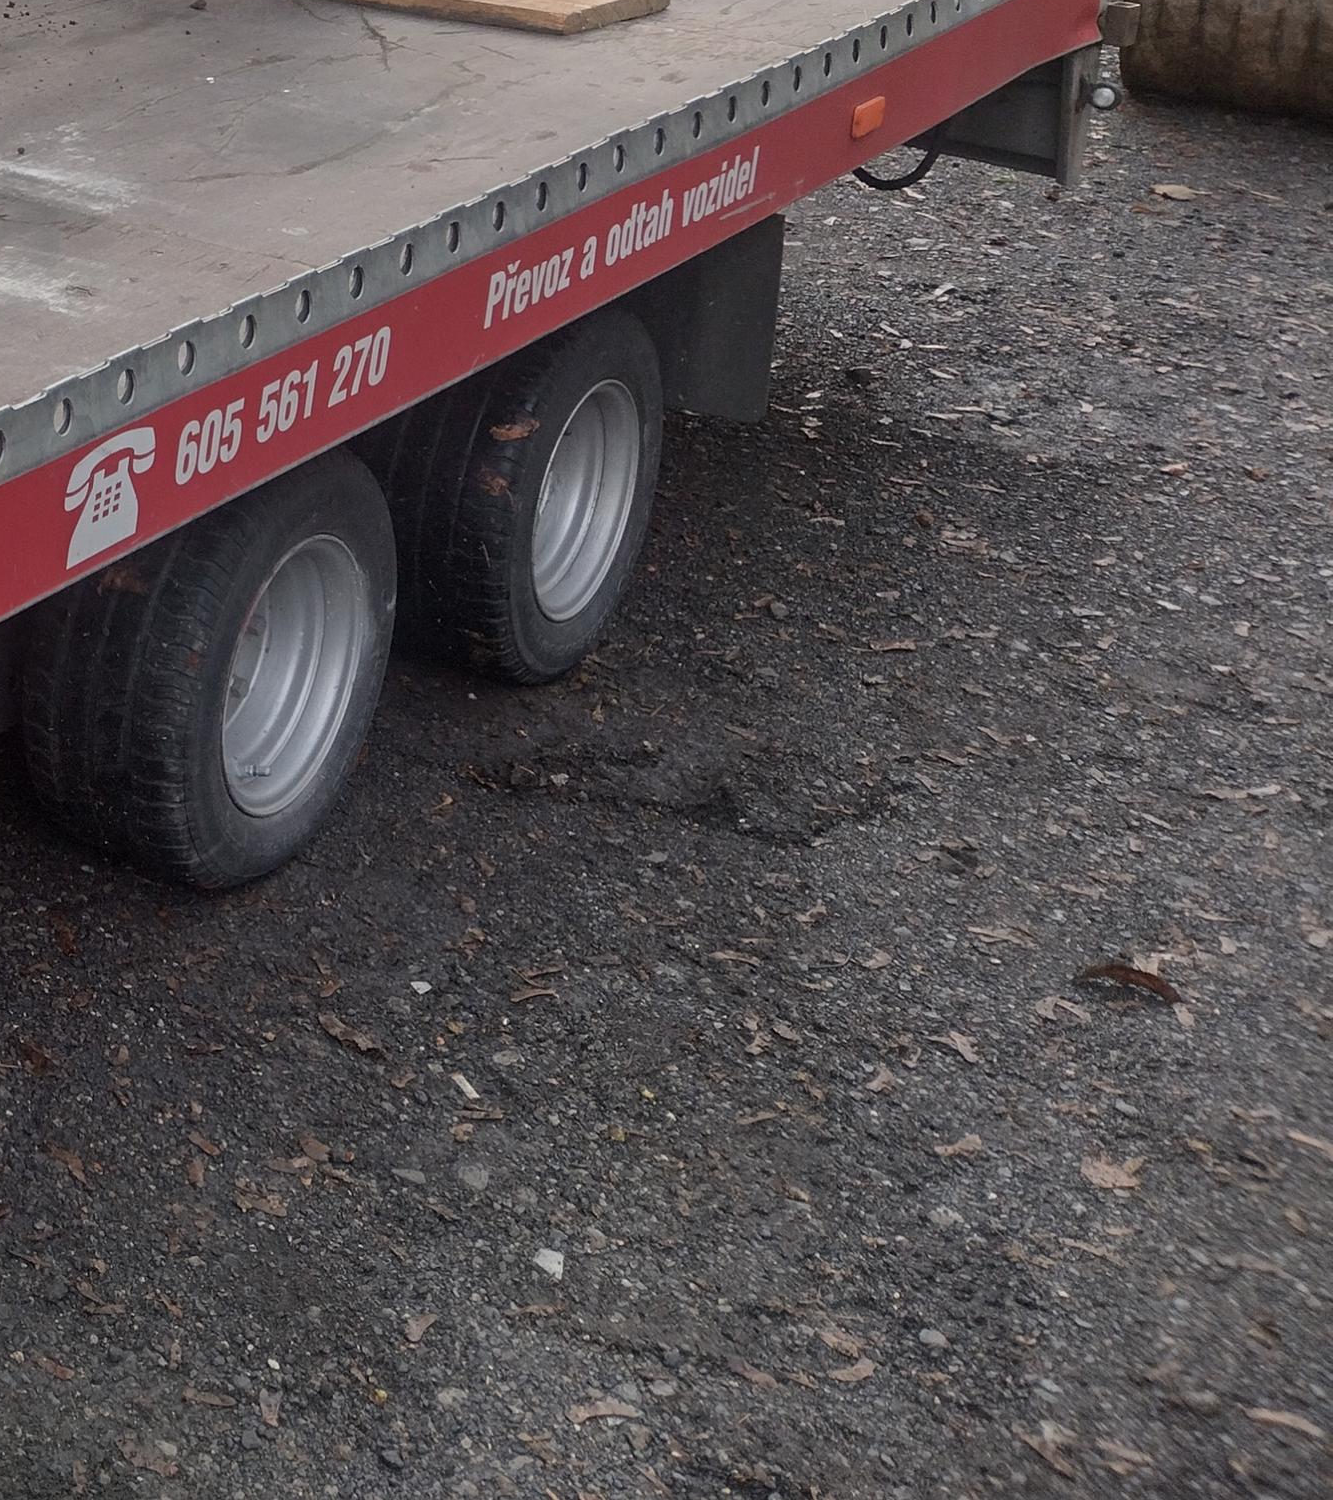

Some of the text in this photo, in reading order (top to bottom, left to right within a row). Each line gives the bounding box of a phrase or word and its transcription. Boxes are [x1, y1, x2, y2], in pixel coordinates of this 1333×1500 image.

[483, 145, 761, 330] Převoz a odtah vozidel
[175, 326, 391, 485] 605 561 270
